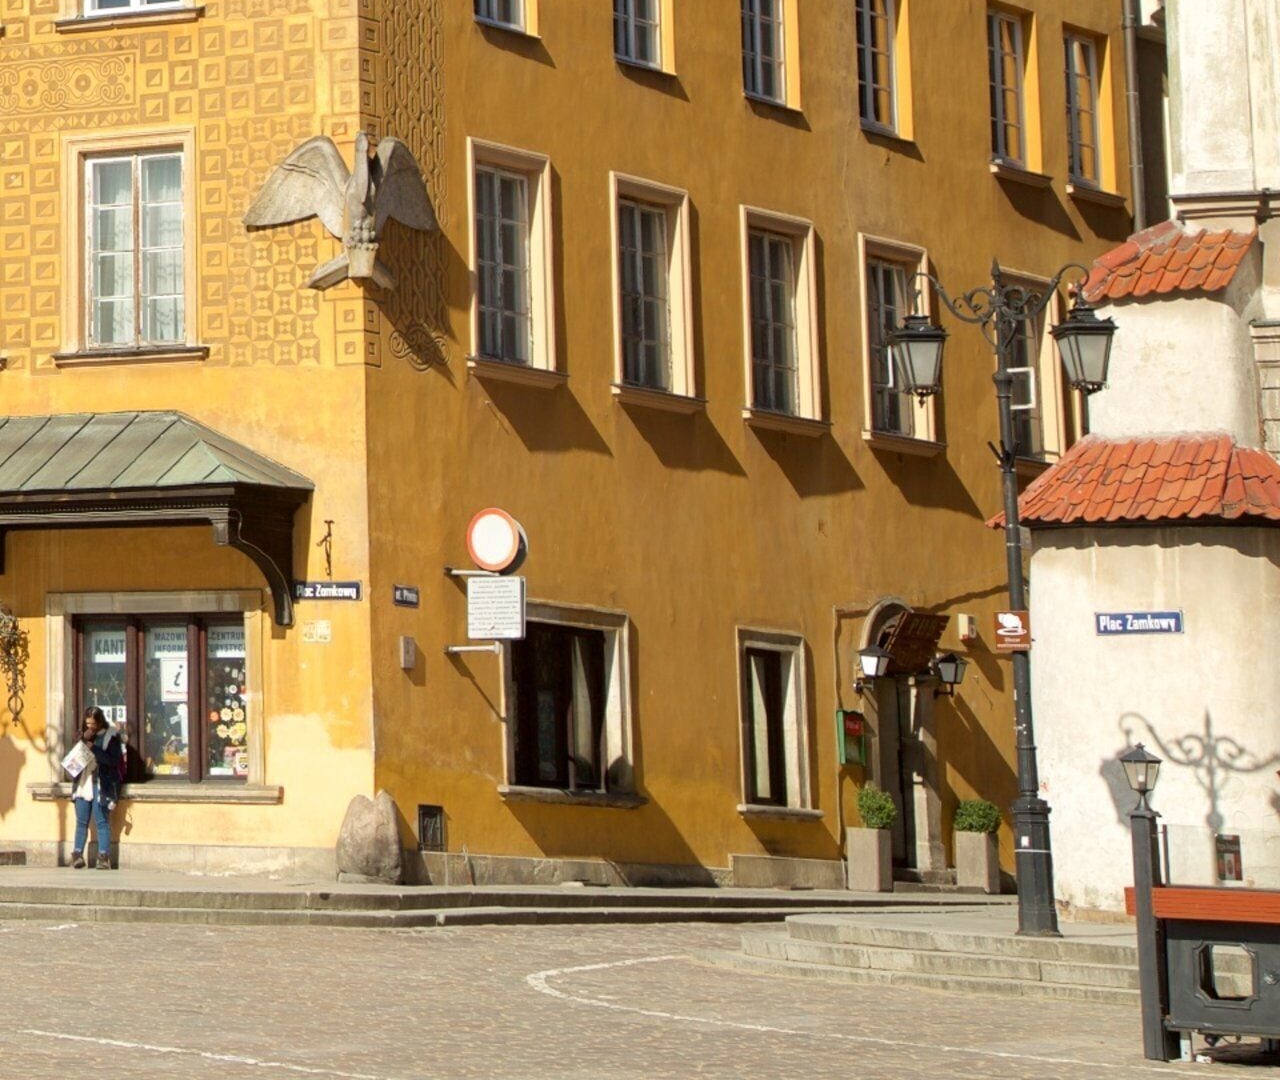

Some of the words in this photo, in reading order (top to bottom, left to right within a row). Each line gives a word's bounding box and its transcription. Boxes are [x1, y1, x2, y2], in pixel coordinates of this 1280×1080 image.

[296, 585, 314, 597] Plac
[315, 584, 357, 599] Zamkowy
[1099, 615, 1123, 631] Plac
[1125, 614, 1176, 632] Zamkowy
